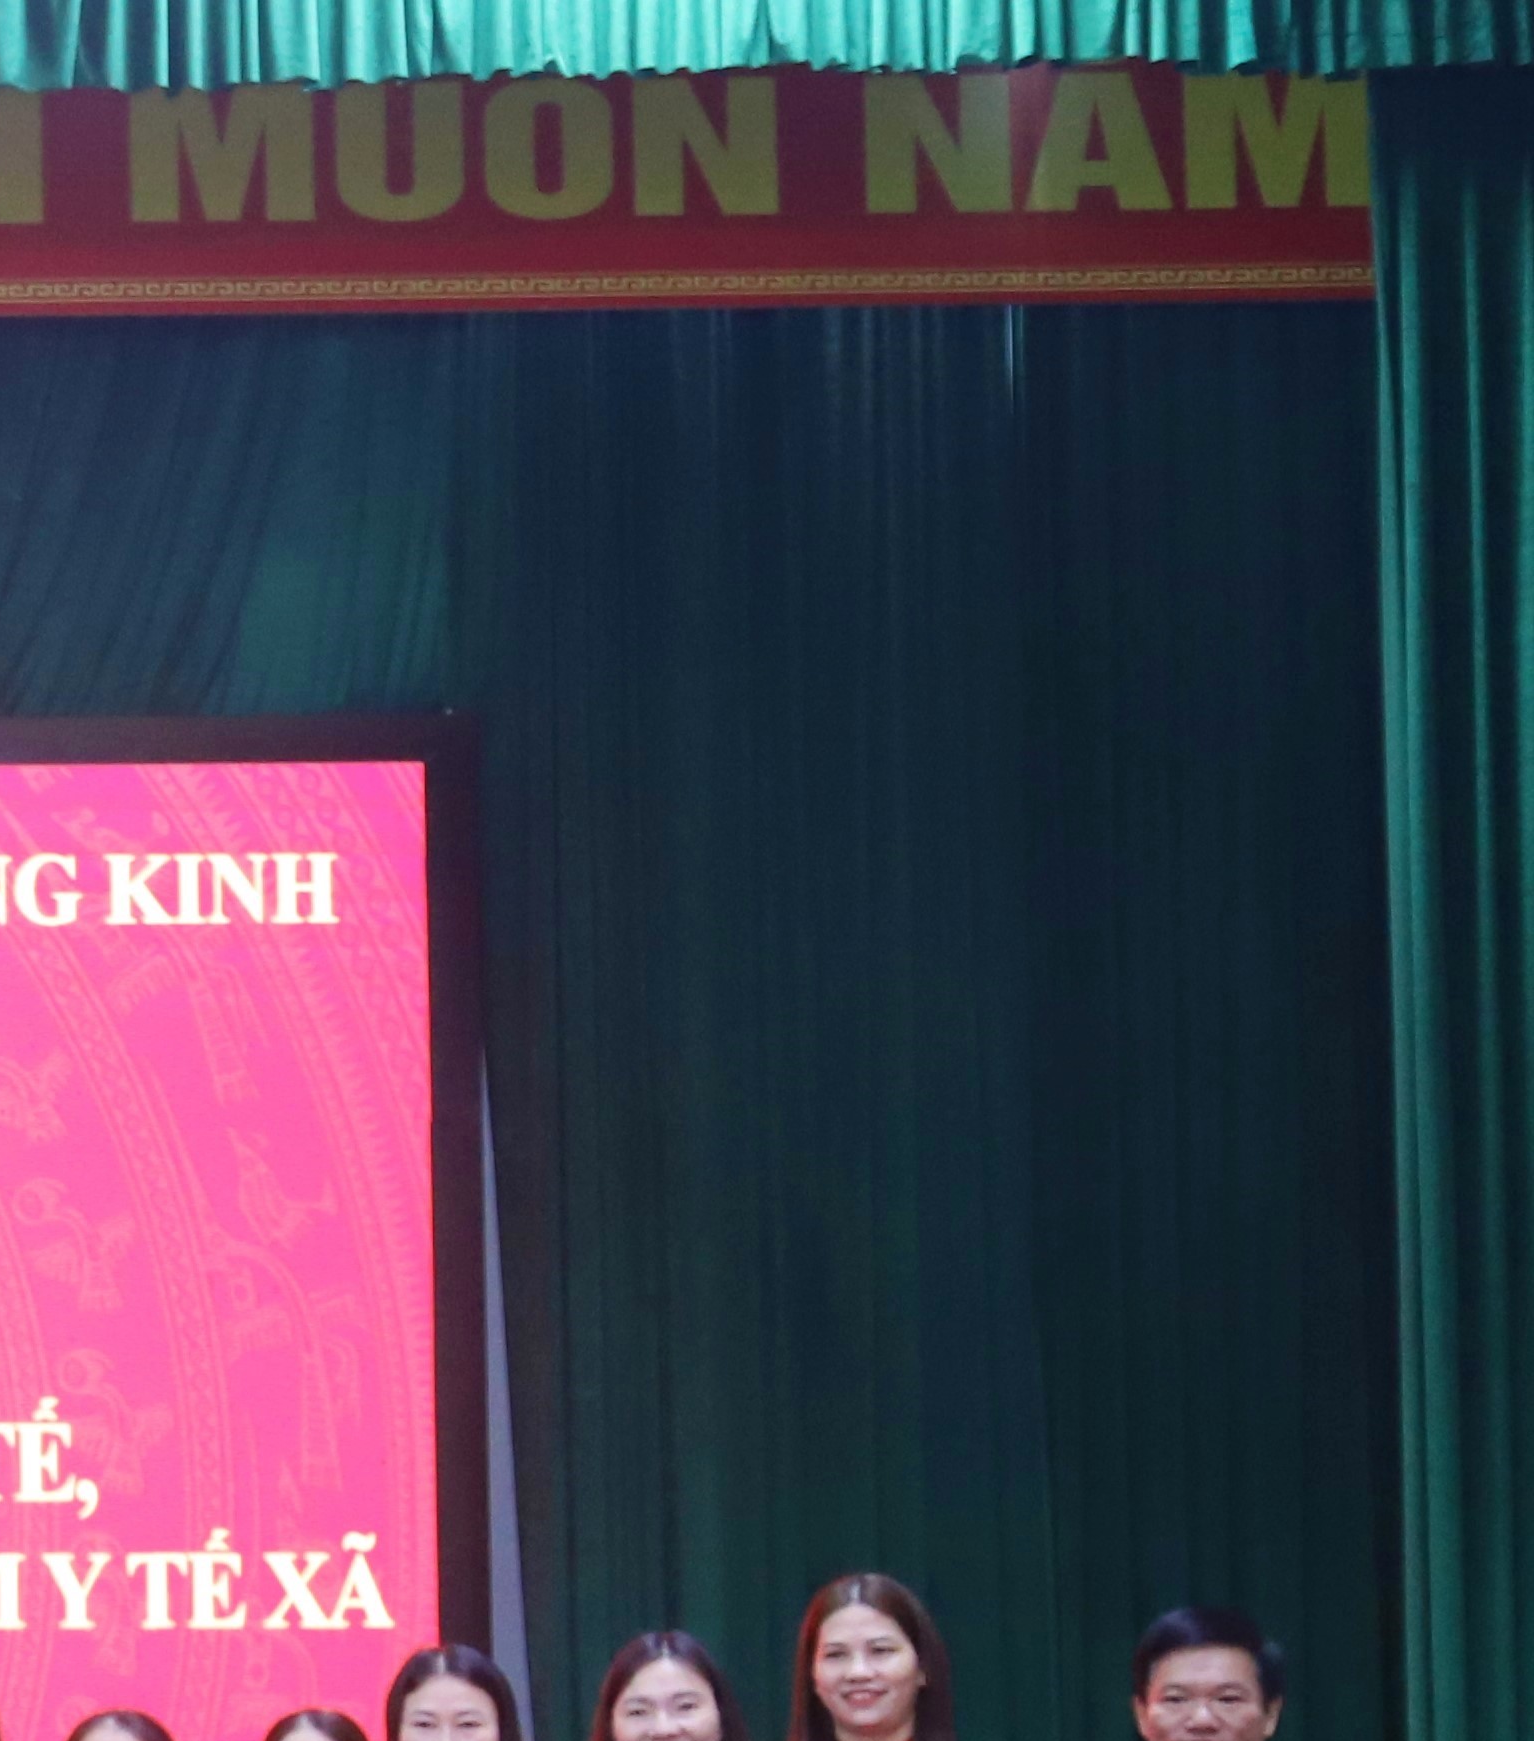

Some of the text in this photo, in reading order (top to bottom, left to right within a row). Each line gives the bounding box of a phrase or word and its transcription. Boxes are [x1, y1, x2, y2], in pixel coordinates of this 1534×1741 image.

[103, 852, 340, 925] KINH
[42, 1552, 112, 1630] Y
[126, 1529, 247, 1630] TẾ
[263, 1533, 396, 1630] XÃ
